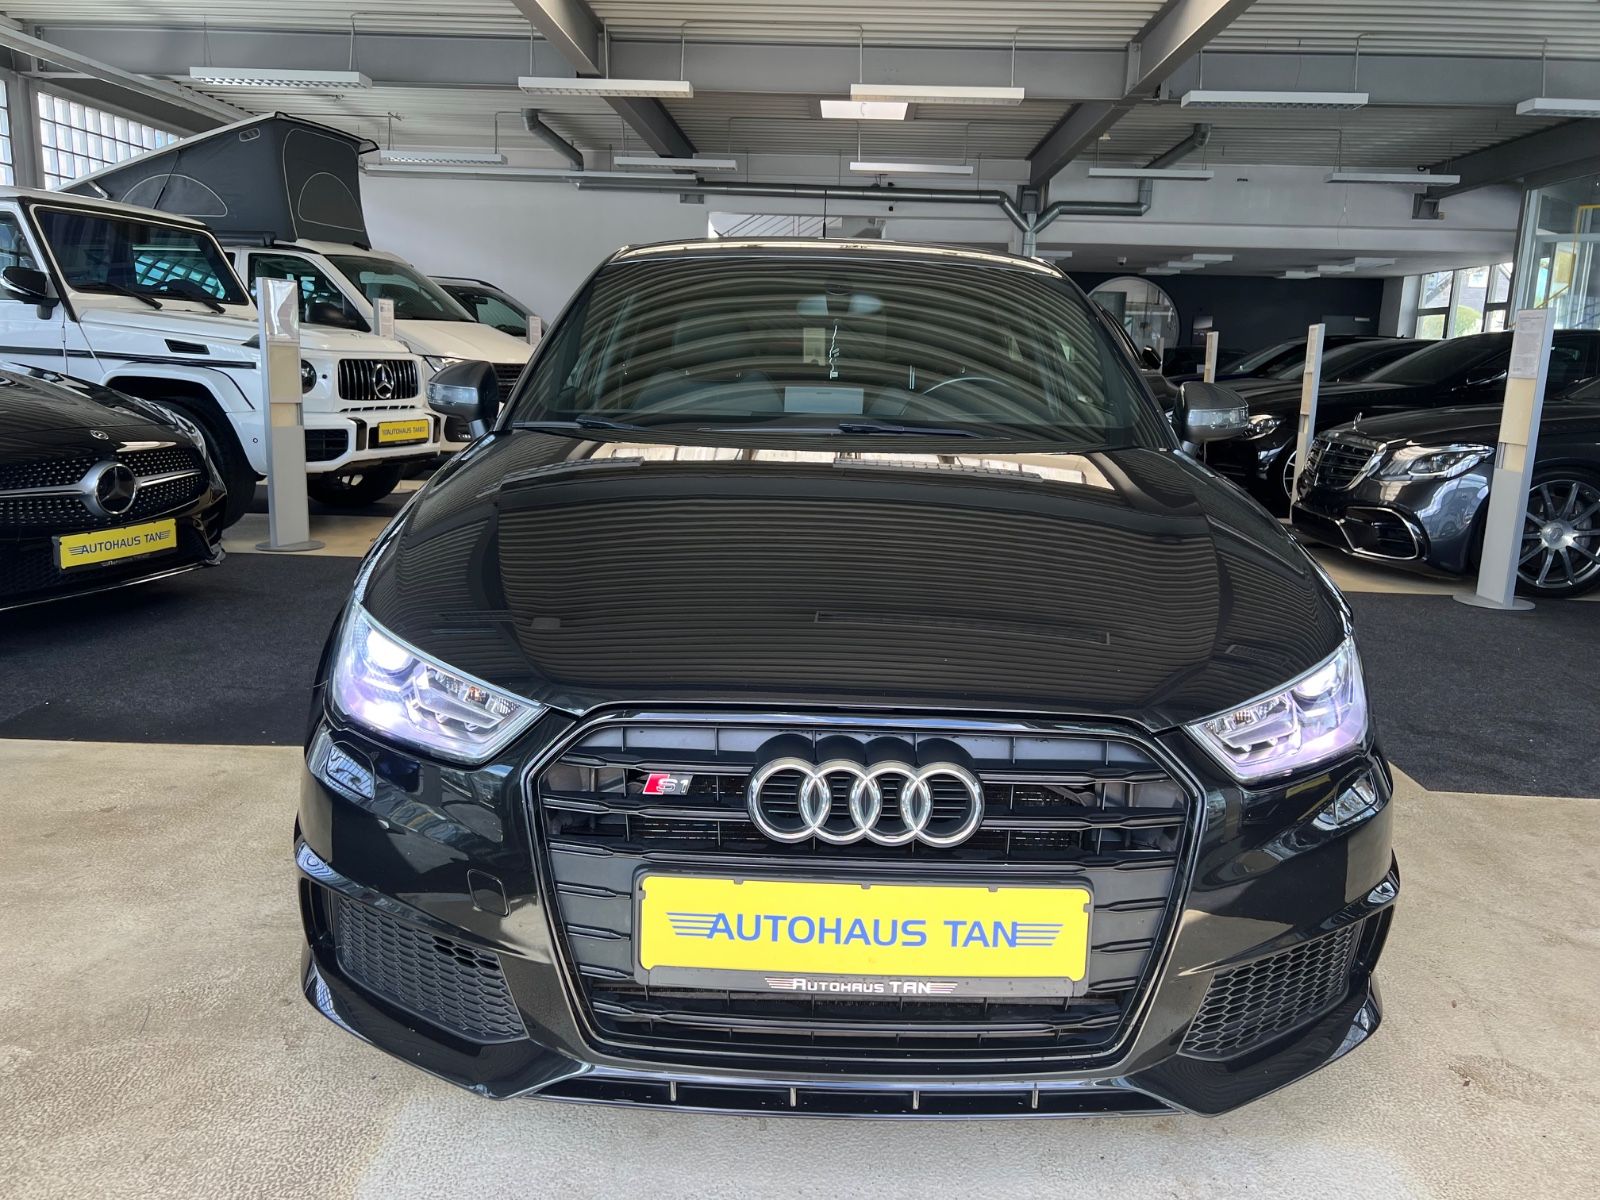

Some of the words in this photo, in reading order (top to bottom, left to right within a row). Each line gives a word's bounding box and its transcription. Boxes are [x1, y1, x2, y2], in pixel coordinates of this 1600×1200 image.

[81, 535, 141, 554] AUTOHAUS
[144, 532, 162, 543] TAN
[656, 778, 689, 793] S1
[707, 913, 927, 947] AUTOHAUS
[943, 920, 1018, 948] TAN
[793, 978, 884, 993] AUTOHAUS
[889, 981, 931, 994] TAN
